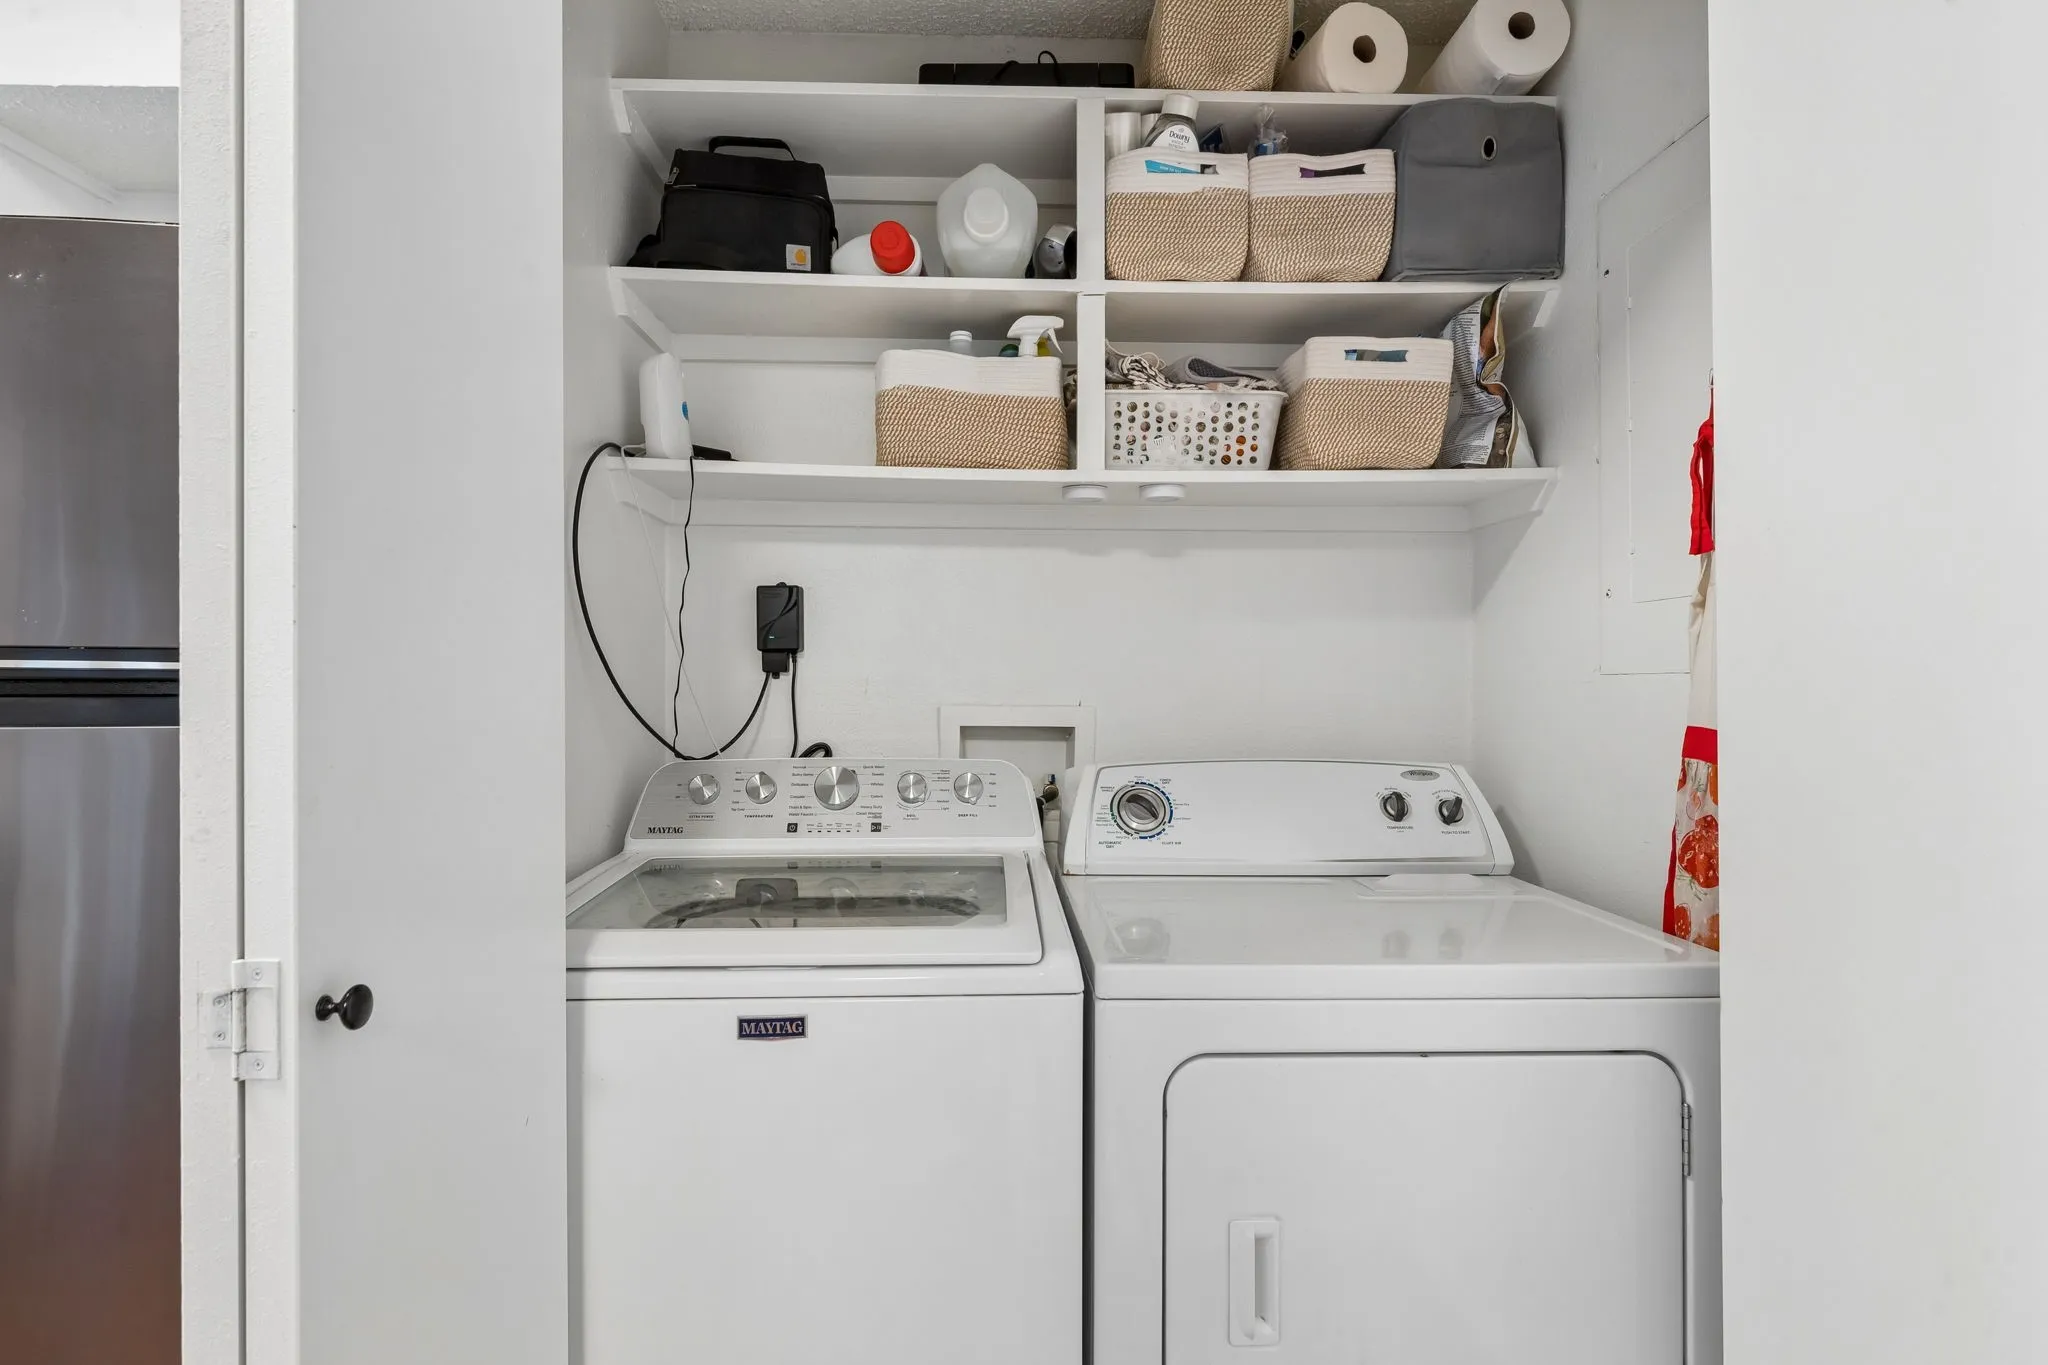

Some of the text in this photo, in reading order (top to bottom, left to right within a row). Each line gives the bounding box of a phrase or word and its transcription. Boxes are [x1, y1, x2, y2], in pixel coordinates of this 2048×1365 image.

[1169, 130, 1190, 143] Downy
[647, 826, 684, 834] MAYTAG
[741, 1020, 804, 1035] MAYTAG
